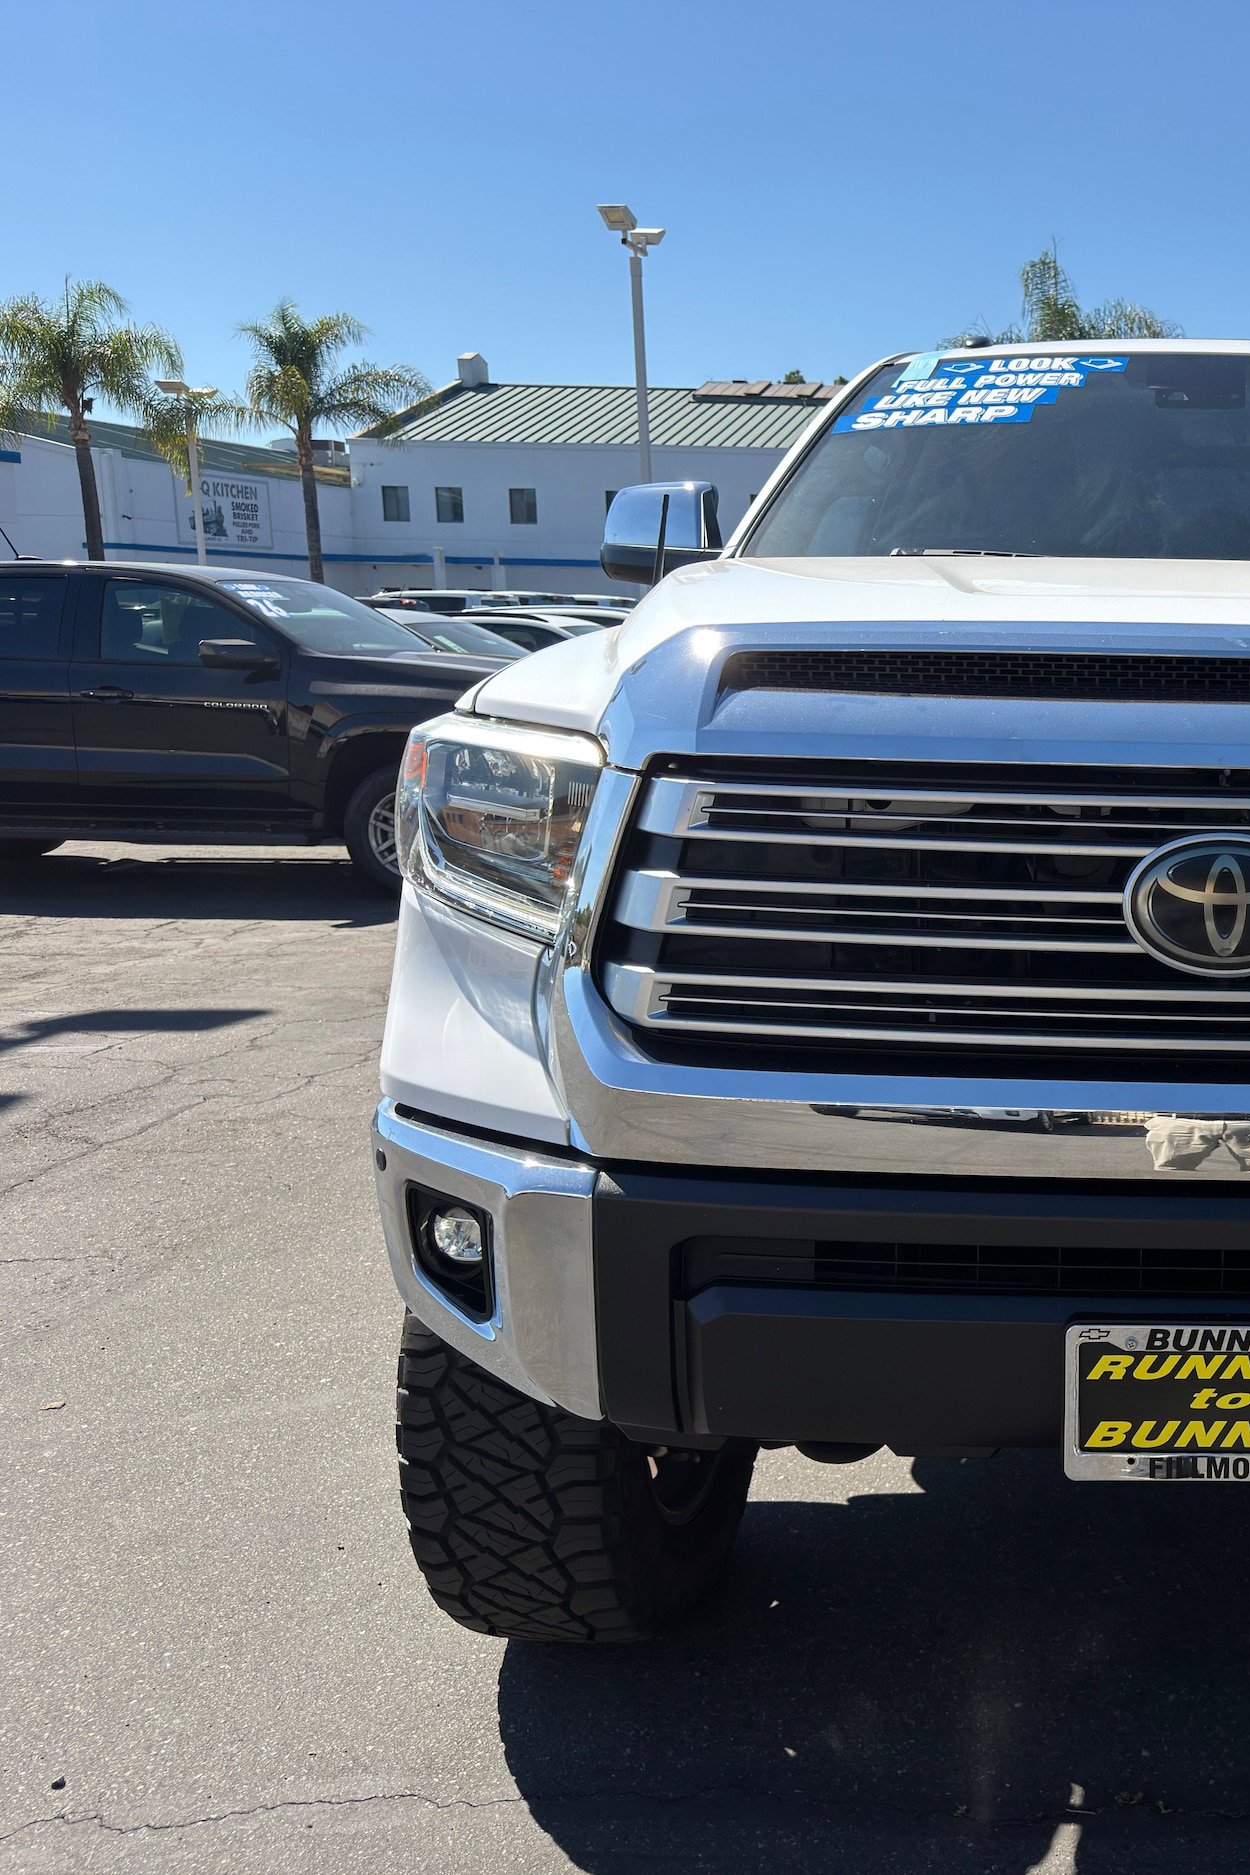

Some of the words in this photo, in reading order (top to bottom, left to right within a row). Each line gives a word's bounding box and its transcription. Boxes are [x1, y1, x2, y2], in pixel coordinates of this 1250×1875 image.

[988, 357, 1079, 373] LOOK
[896, 377, 967, 394] FULL
[973, 372, 1085, 389] POWER
[873, 389, 957, 410] LIKE
[957, 387, 1047, 406] NEW
[850, 405, 1019, 431] SHARP
[201, 480, 211, 498] Q
[213, 482, 258, 501] KITCHEN
[231, 501, 259, 513] SMOKED
[232, 512, 258, 521] BRISKET
[236, 535, 258, 543] TRI-TIP
[203, 701, 268, 710] COLORADO
